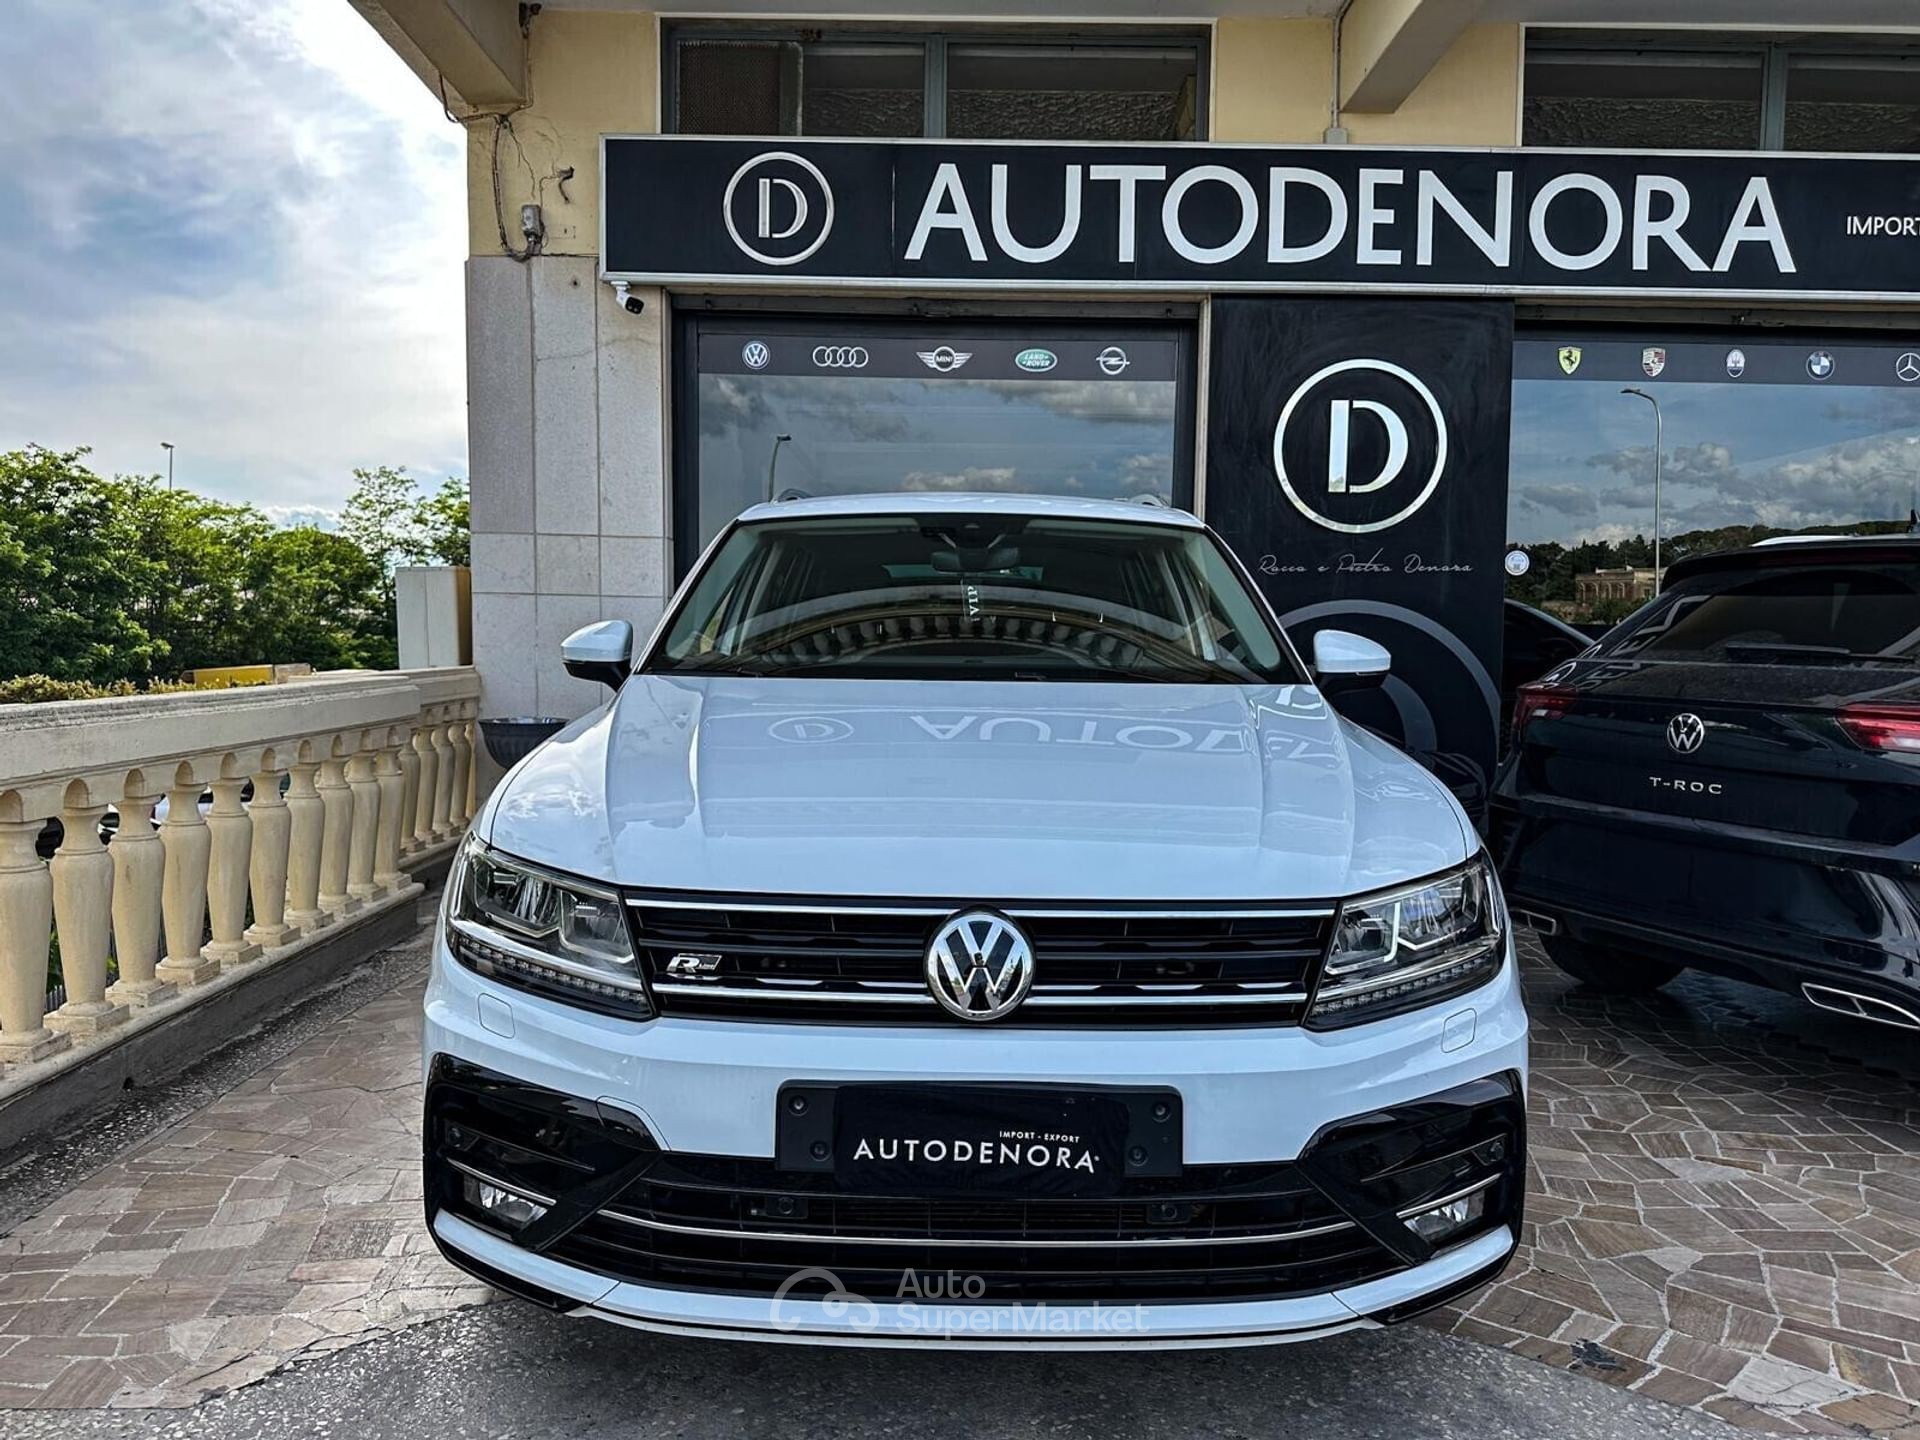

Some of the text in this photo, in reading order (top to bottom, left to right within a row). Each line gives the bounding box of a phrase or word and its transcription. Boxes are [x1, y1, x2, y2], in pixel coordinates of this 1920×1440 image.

[758, 178, 808, 239] D
[904, 162, 1797, 273] AUTODENORA
[1328, 400, 1409, 493] D
[1650, 776, 1723, 794] T-ROC
[999, 1131, 1036, 1140] IMPORT
[1044, 1133, 1080, 1143] EXPORT
